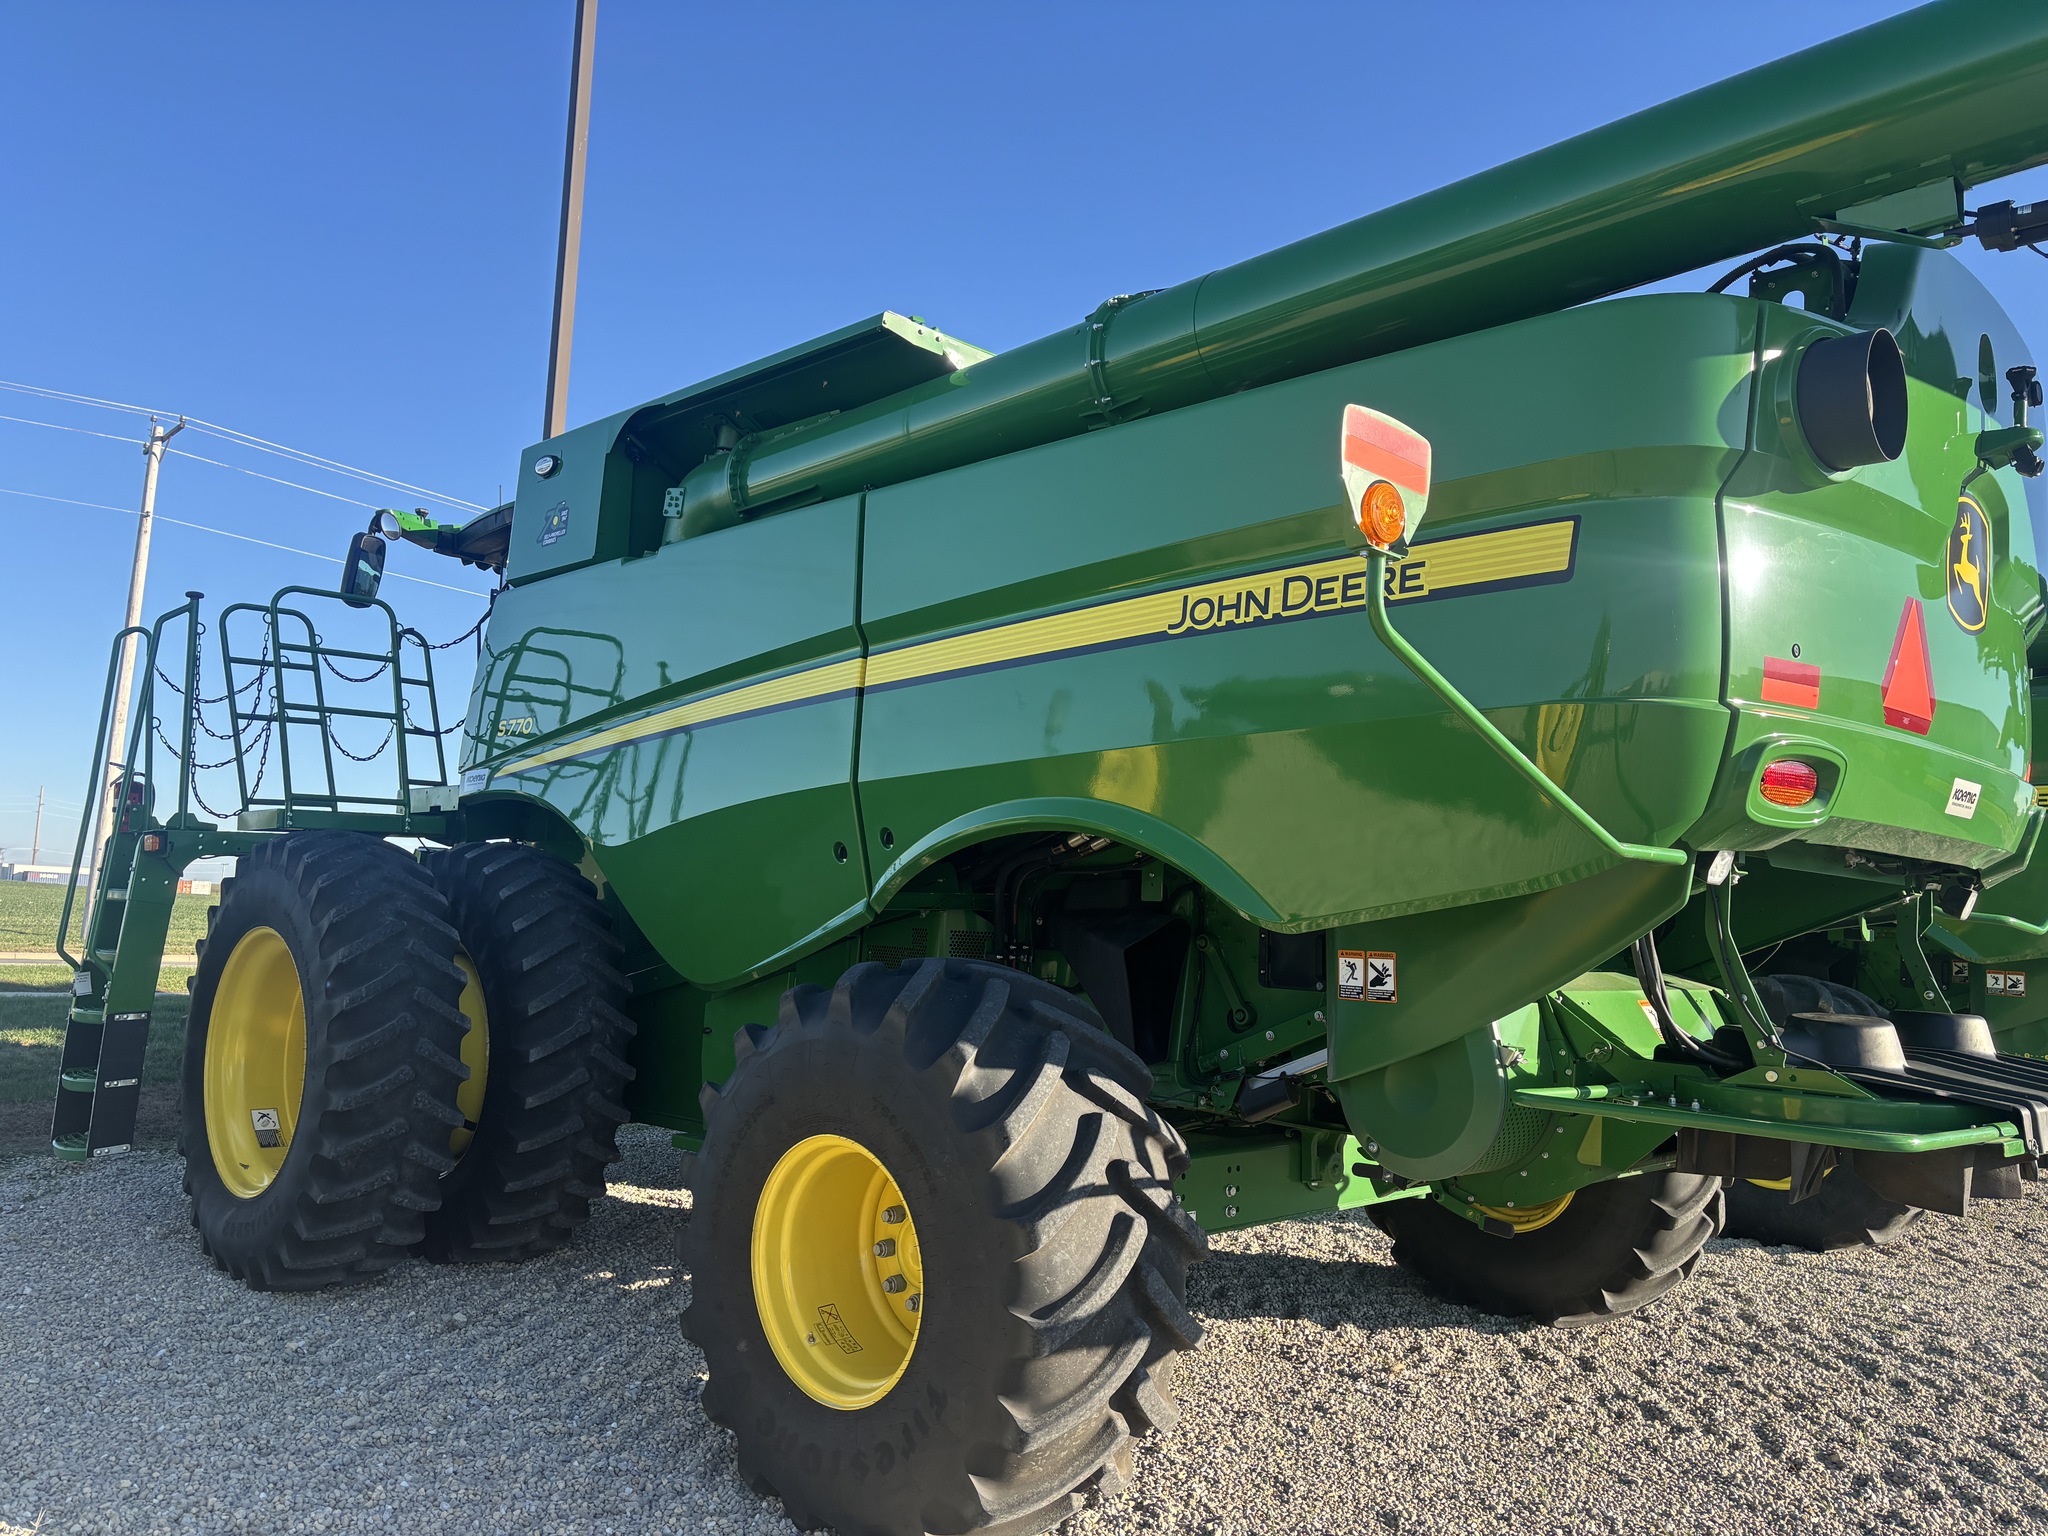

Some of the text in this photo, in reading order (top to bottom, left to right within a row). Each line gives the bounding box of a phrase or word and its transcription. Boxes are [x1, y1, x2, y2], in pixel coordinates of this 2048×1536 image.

[1168, 561, 1426, 630] JOHN DEERE
[497, 717, 533, 737] S770
